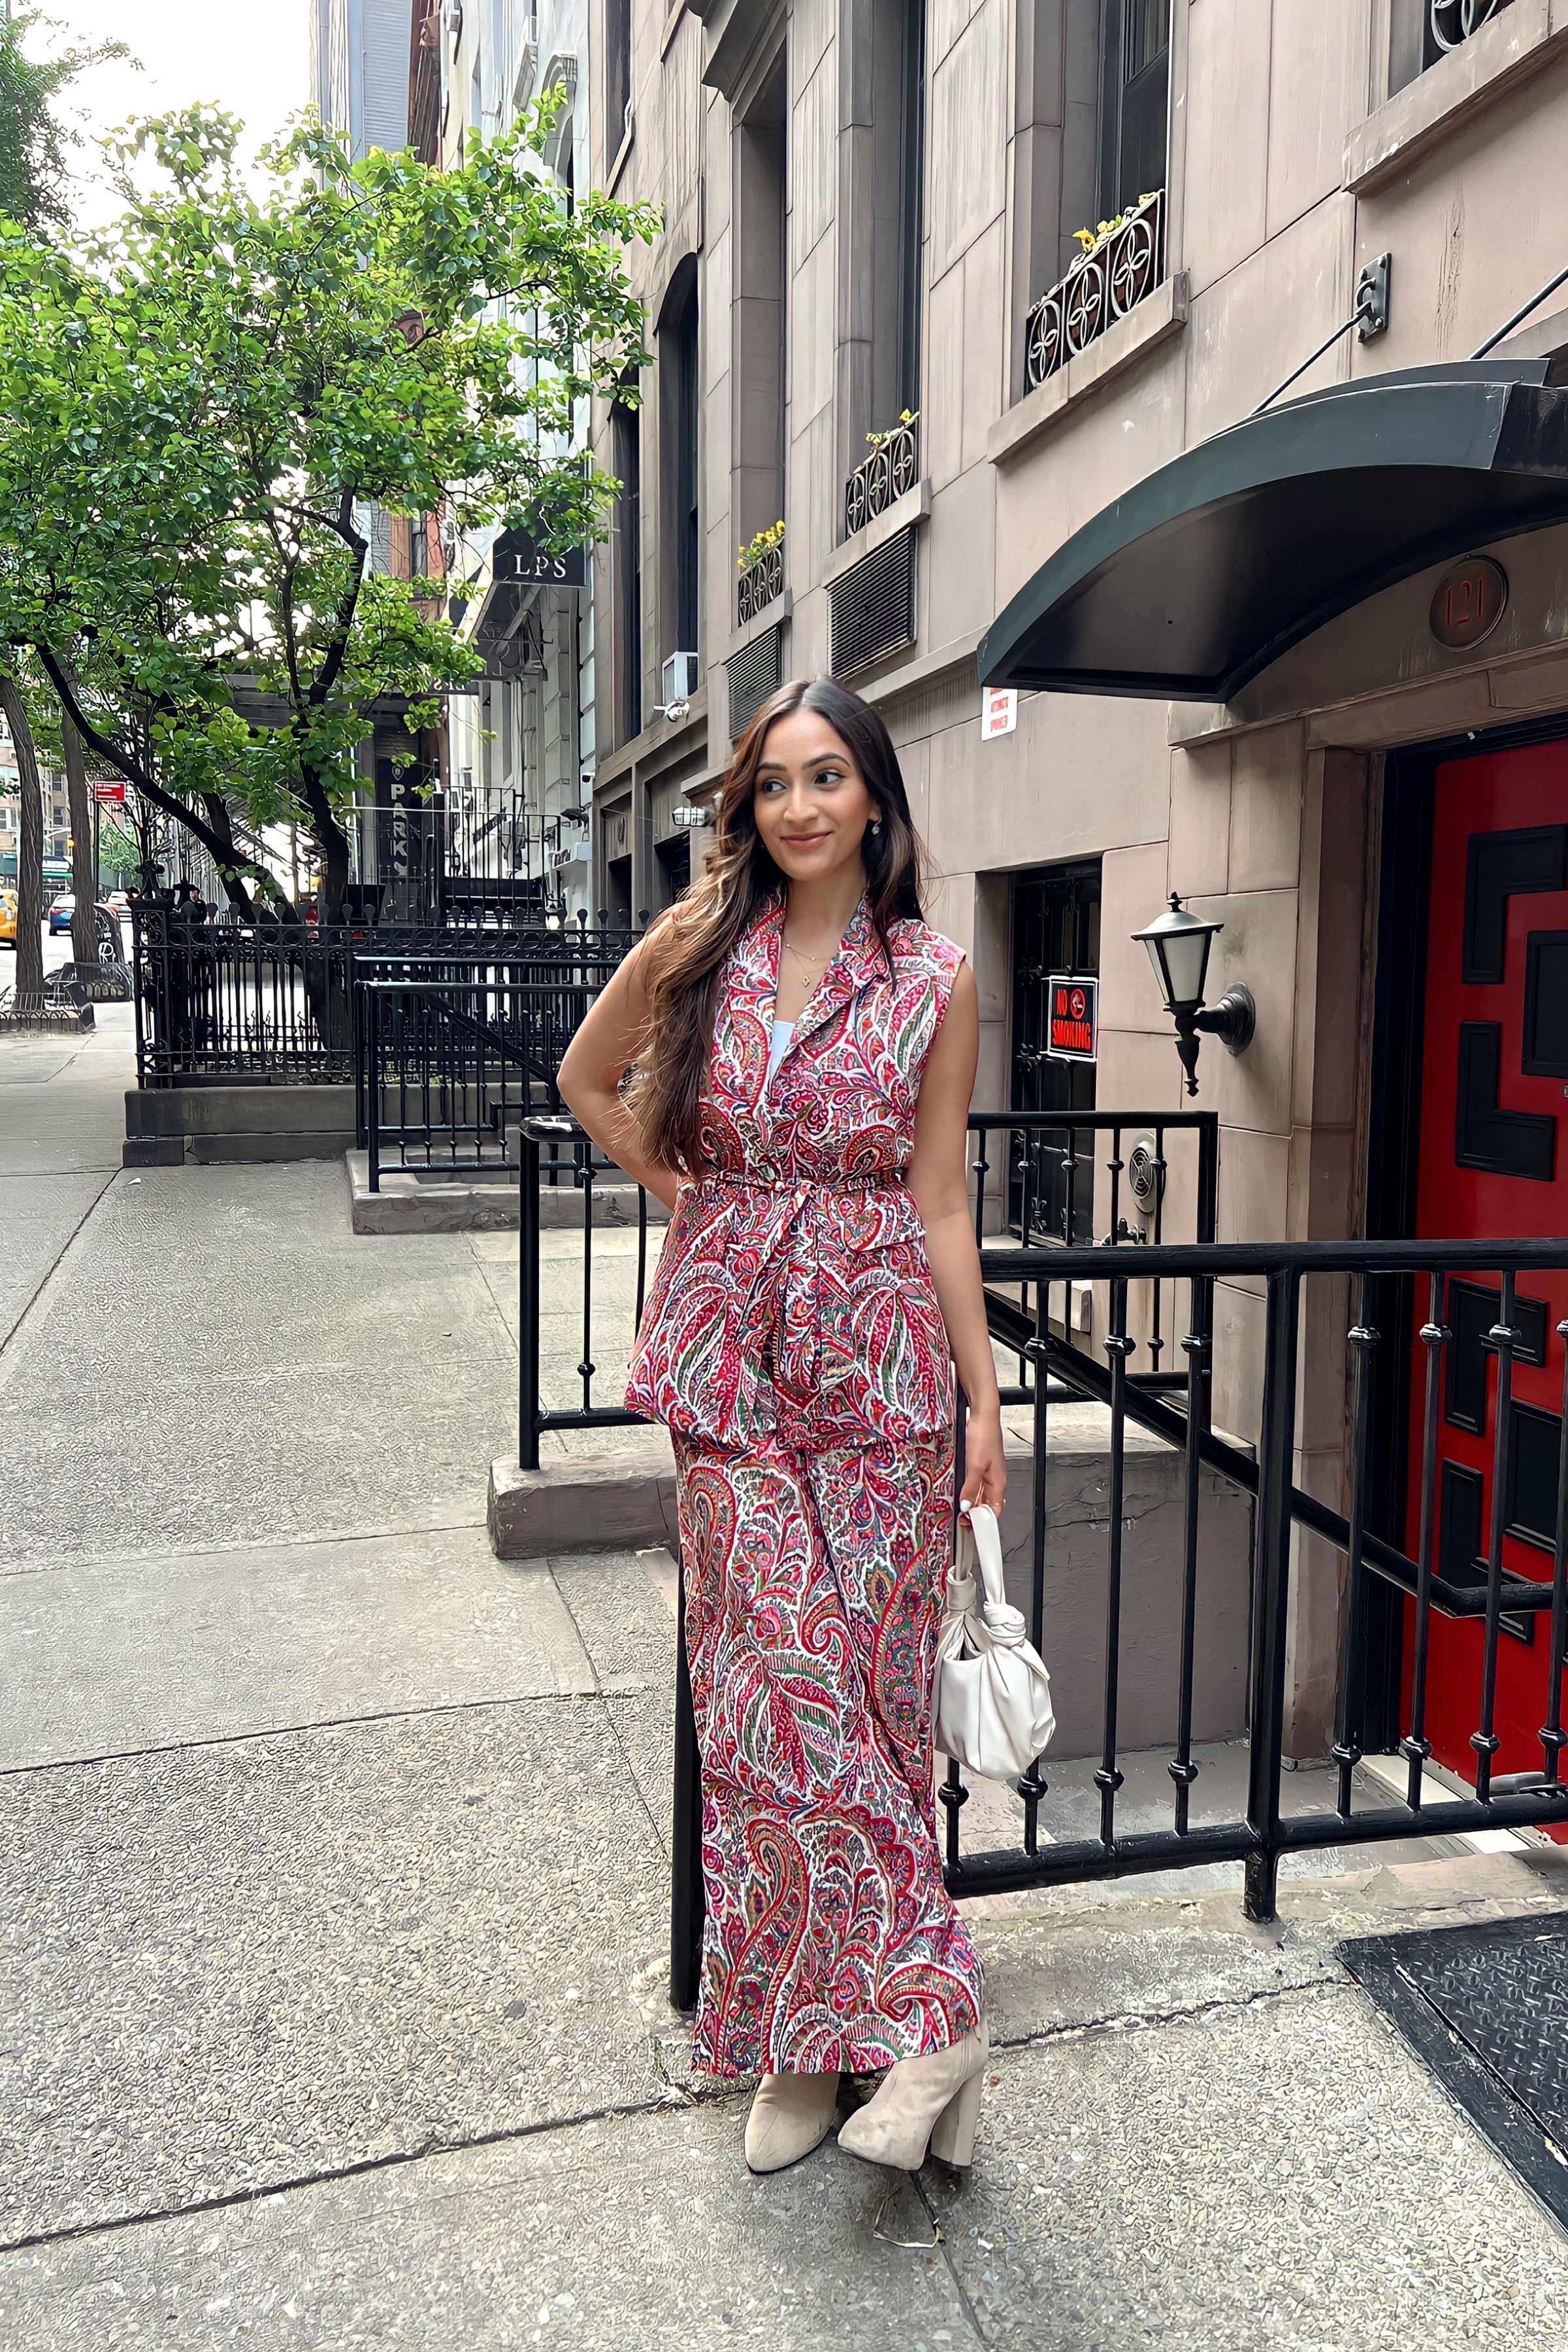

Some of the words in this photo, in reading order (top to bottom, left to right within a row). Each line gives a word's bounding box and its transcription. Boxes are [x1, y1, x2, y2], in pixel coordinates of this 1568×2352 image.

[514, 554, 566, 578] LPS
[1445, 575, 1484, 627] 121
[1056, 988, 1068, 1017] NO
[1052, 1019, 1091, 1050] SMOKING
